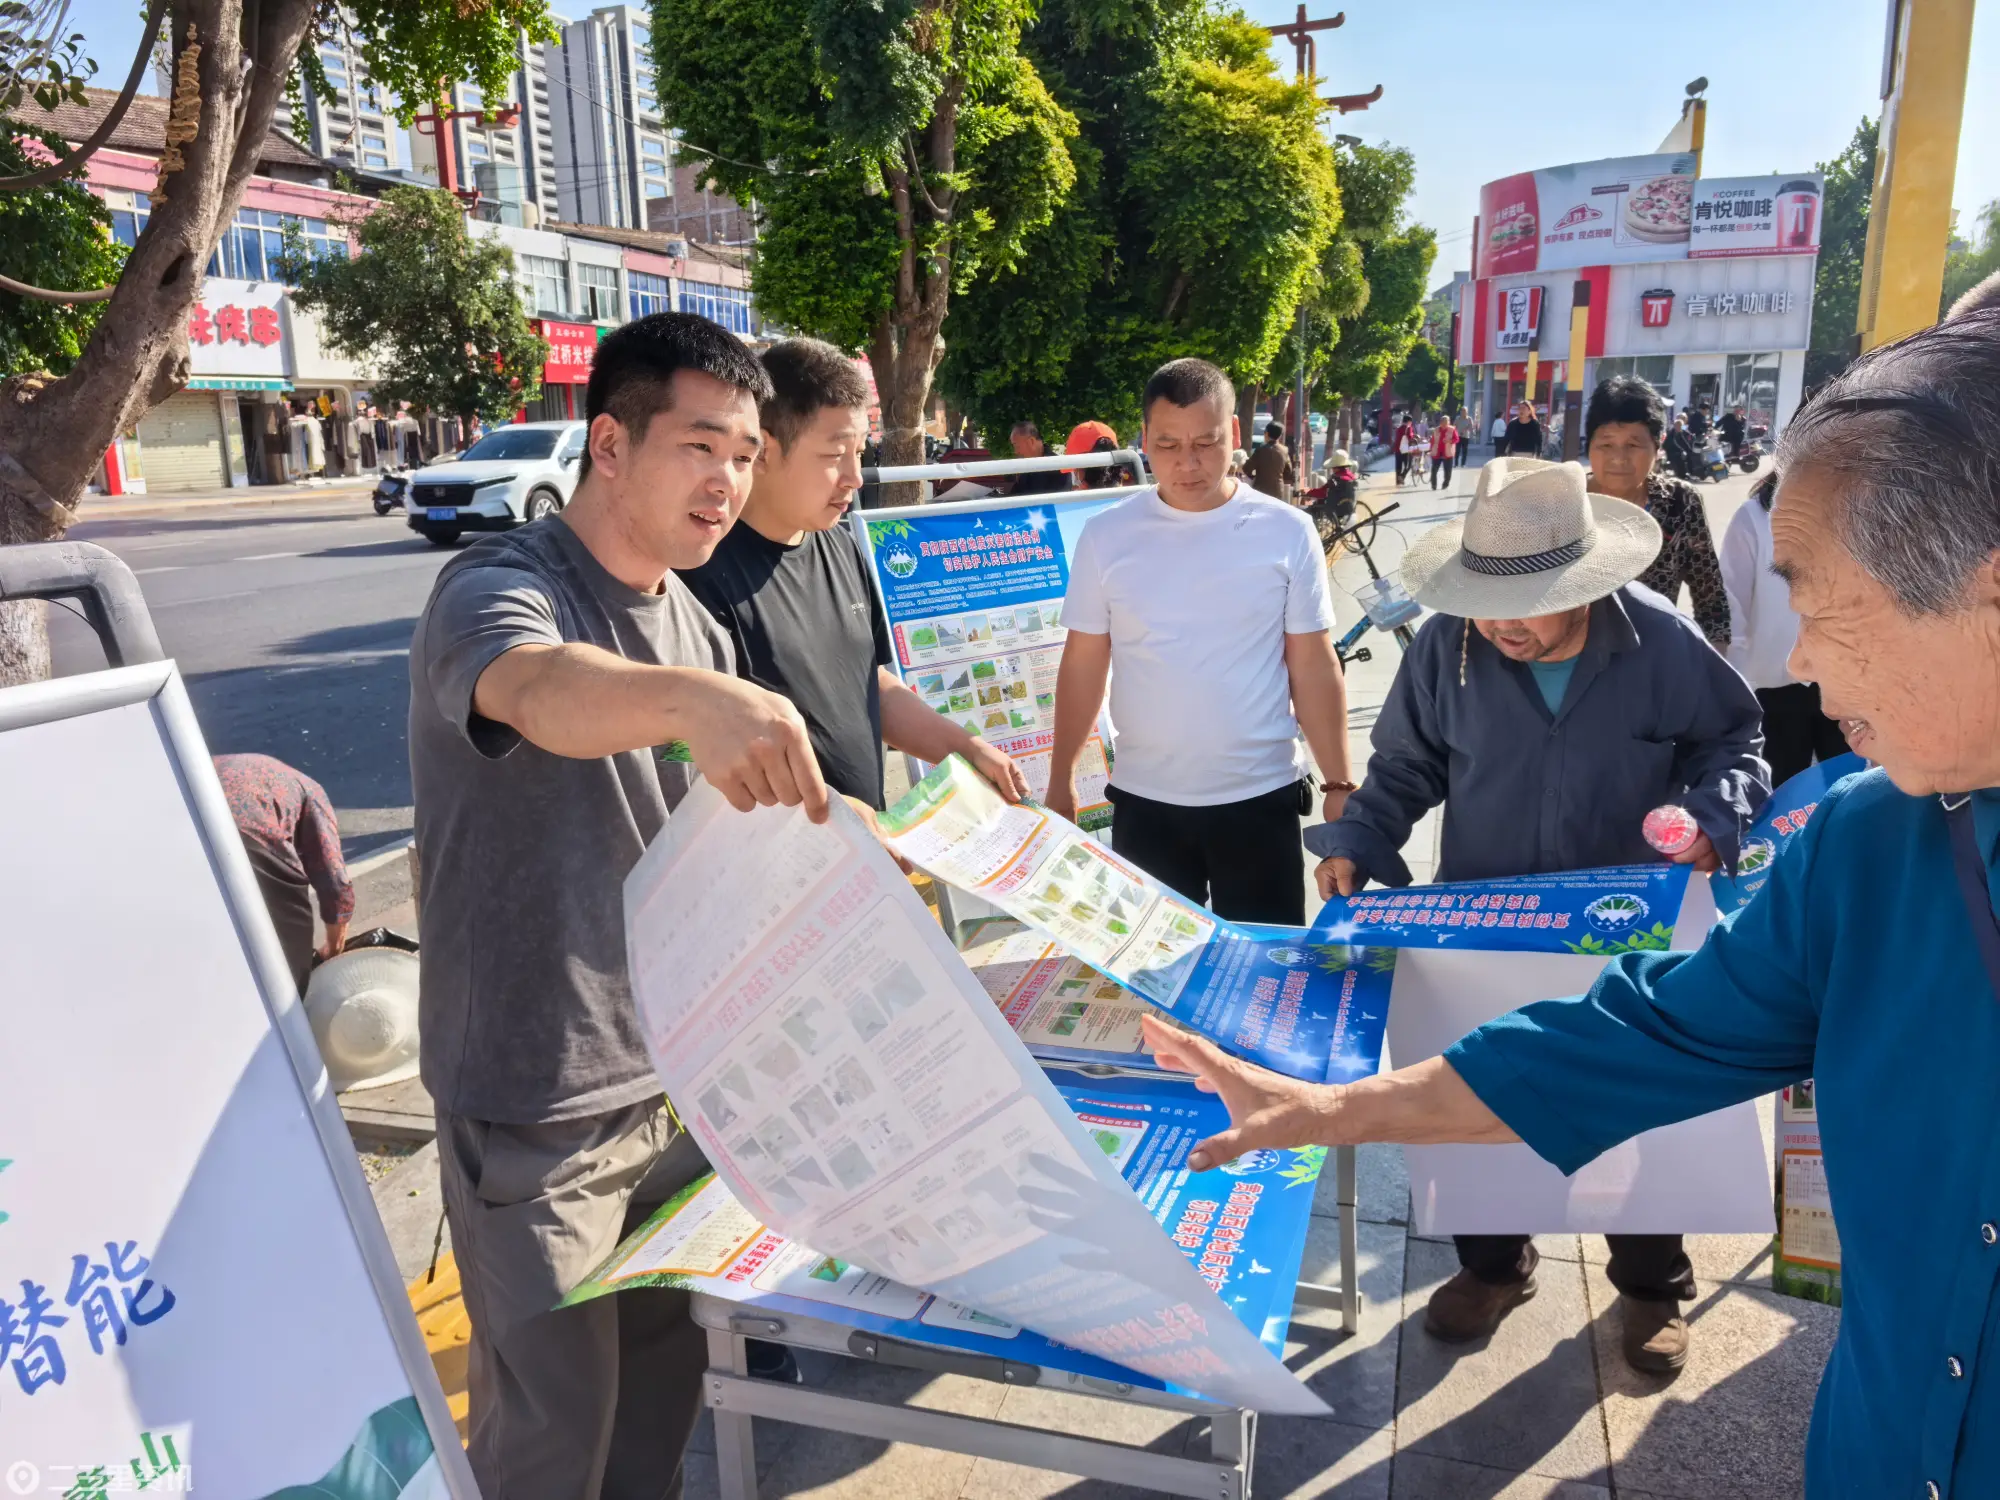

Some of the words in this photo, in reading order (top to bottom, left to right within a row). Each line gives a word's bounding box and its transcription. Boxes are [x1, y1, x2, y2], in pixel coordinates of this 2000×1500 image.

[1694, 199, 1773, 220] 肯悦咖啡
[1686, 291, 1795, 317] 肯悦咖啡
